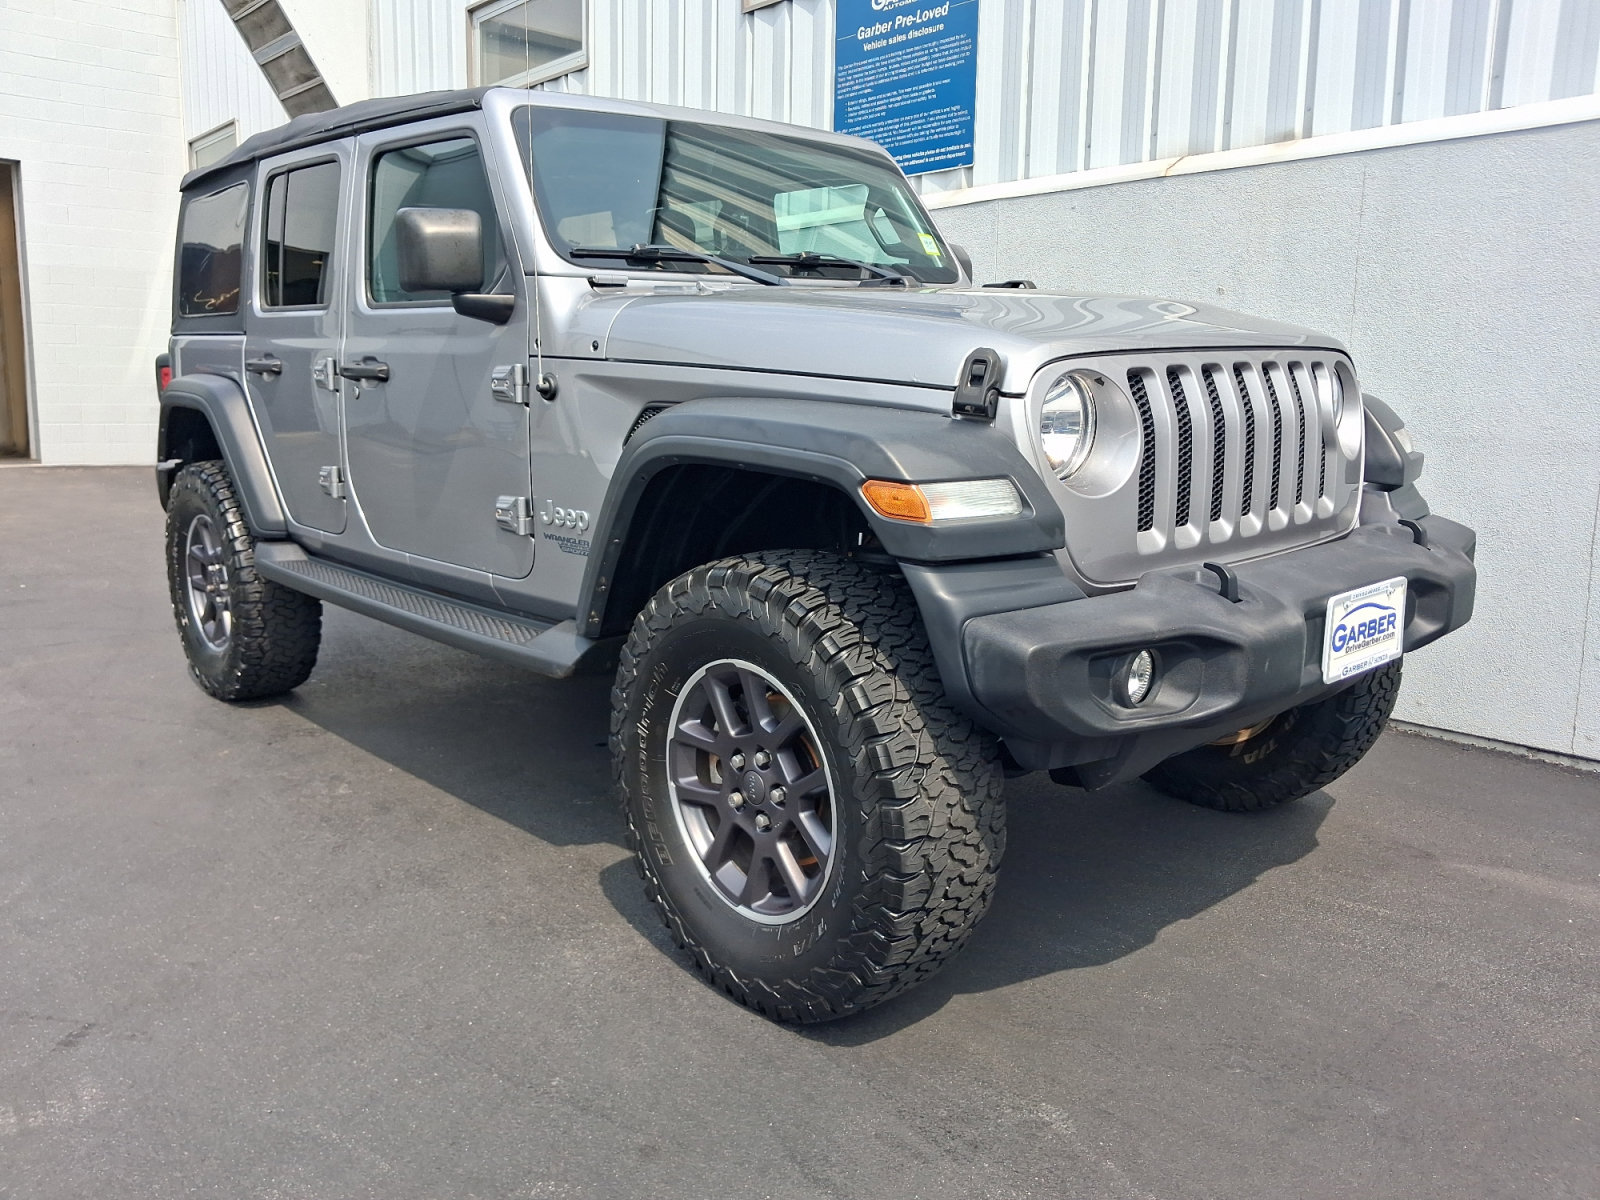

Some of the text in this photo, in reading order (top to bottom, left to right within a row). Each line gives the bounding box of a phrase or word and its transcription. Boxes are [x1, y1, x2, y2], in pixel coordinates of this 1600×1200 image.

[857, 22, 893, 40] Garber
[894, 1, 950, 29] Pre-Loved
[863, 23, 944, 52] Vehicle sales disclosure
[540, 499, 590, 535] Jeep
[543, 532, 590, 547] WRANGLER
[1332, 612, 1396, 653] GARBER
[1345, 631, 1395, 654] DriveGarber.com
[634, 661, 674, 867] BFGoodrich
